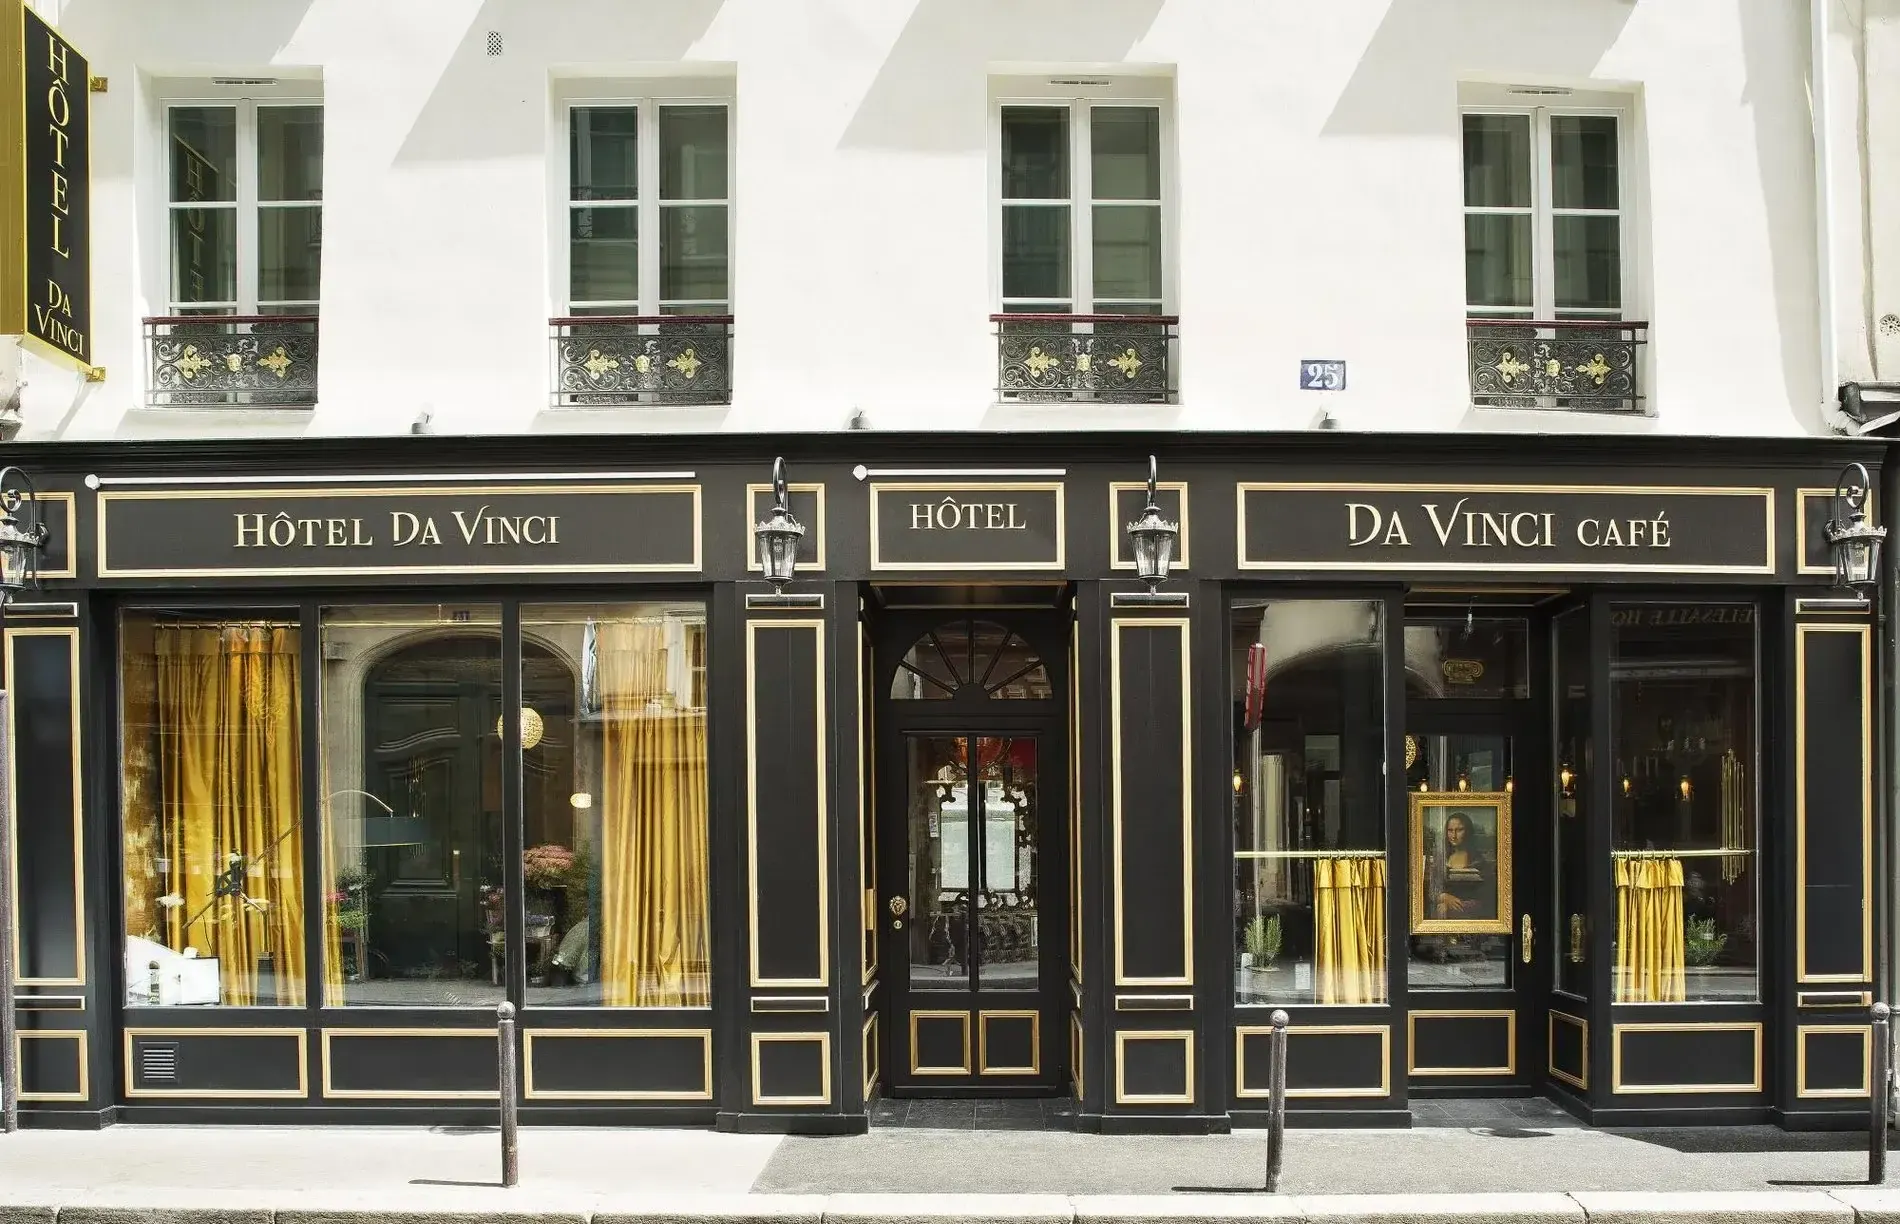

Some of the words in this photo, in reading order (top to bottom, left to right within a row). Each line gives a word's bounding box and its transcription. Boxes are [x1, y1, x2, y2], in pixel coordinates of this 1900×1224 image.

[46, 31, 70, 259] HÔTEL
[47, 278, 73, 318] DA
[34, 303, 84, 356] VINCI
[1307, 363, 1339, 389] 25
[233, 511, 373, 547] HÔTEL
[390, 511, 443, 547] DA
[451, 505, 560, 545] VINCI
[908, 495, 1027, 530] HÔTEL
[1344, 503, 1412, 547] DA
[1421, 497, 1557, 547] VINCI
[1576, 510, 1671, 547] CAFÉ
